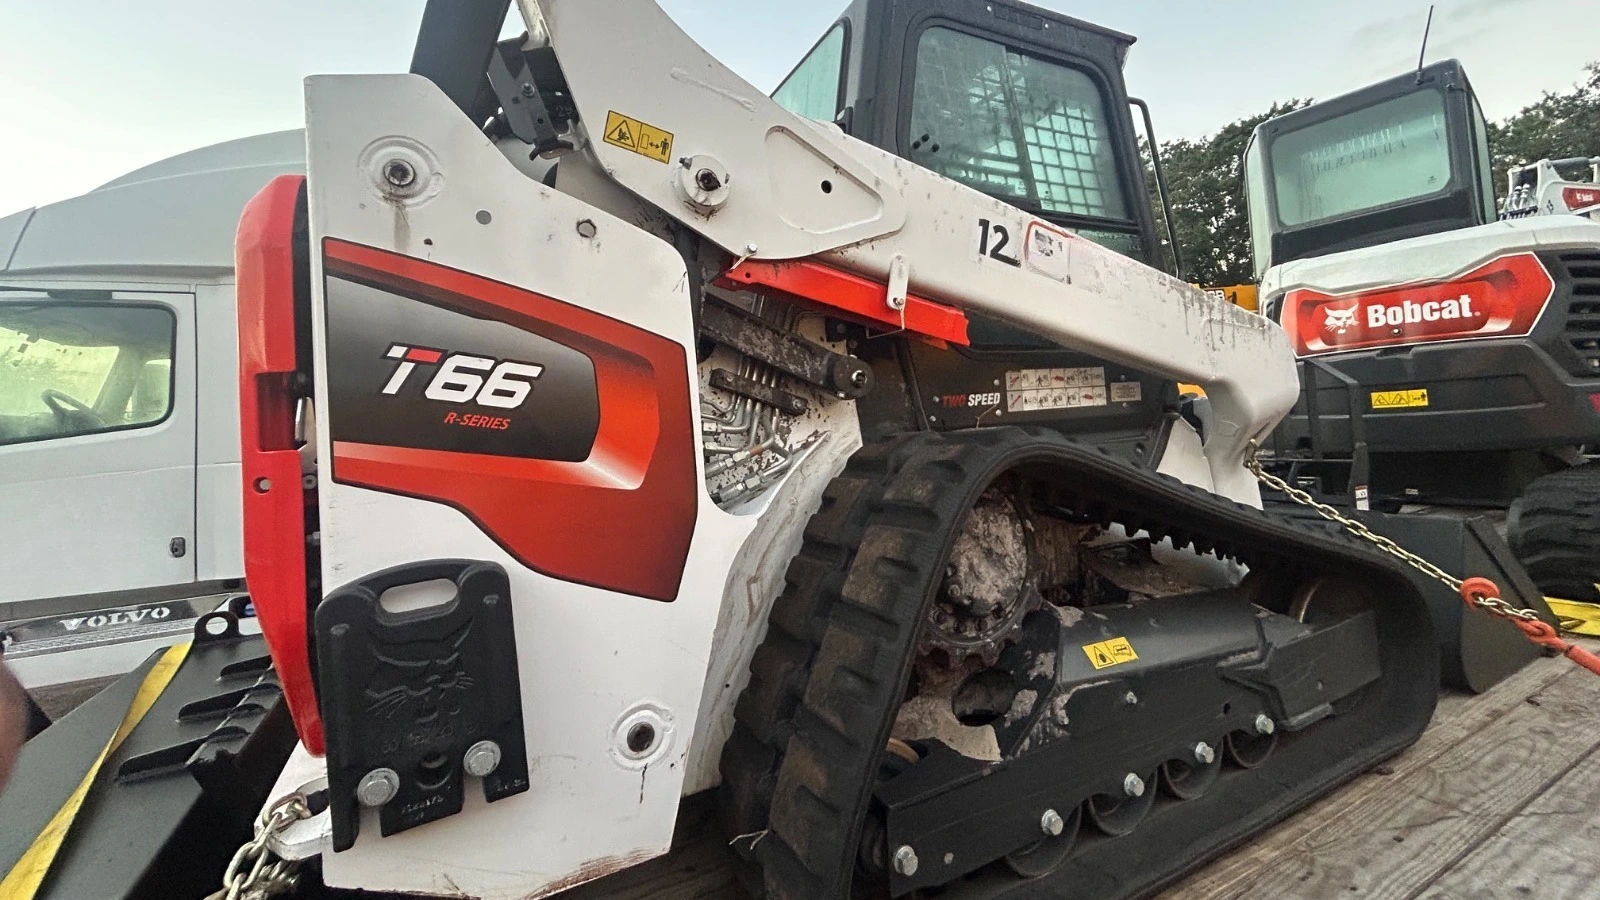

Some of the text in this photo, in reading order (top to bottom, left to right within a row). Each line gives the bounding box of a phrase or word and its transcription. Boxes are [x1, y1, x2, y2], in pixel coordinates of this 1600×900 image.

[978, 218, 1021, 268] 12
[1367, 293, 1473, 328] Bobcat
[381, 344, 543, 409] T66
[942, 392, 1001, 407] TWO SPEED
[444, 412, 511, 430] R-SERIES
[59, 606, 170, 631] VOLVO
